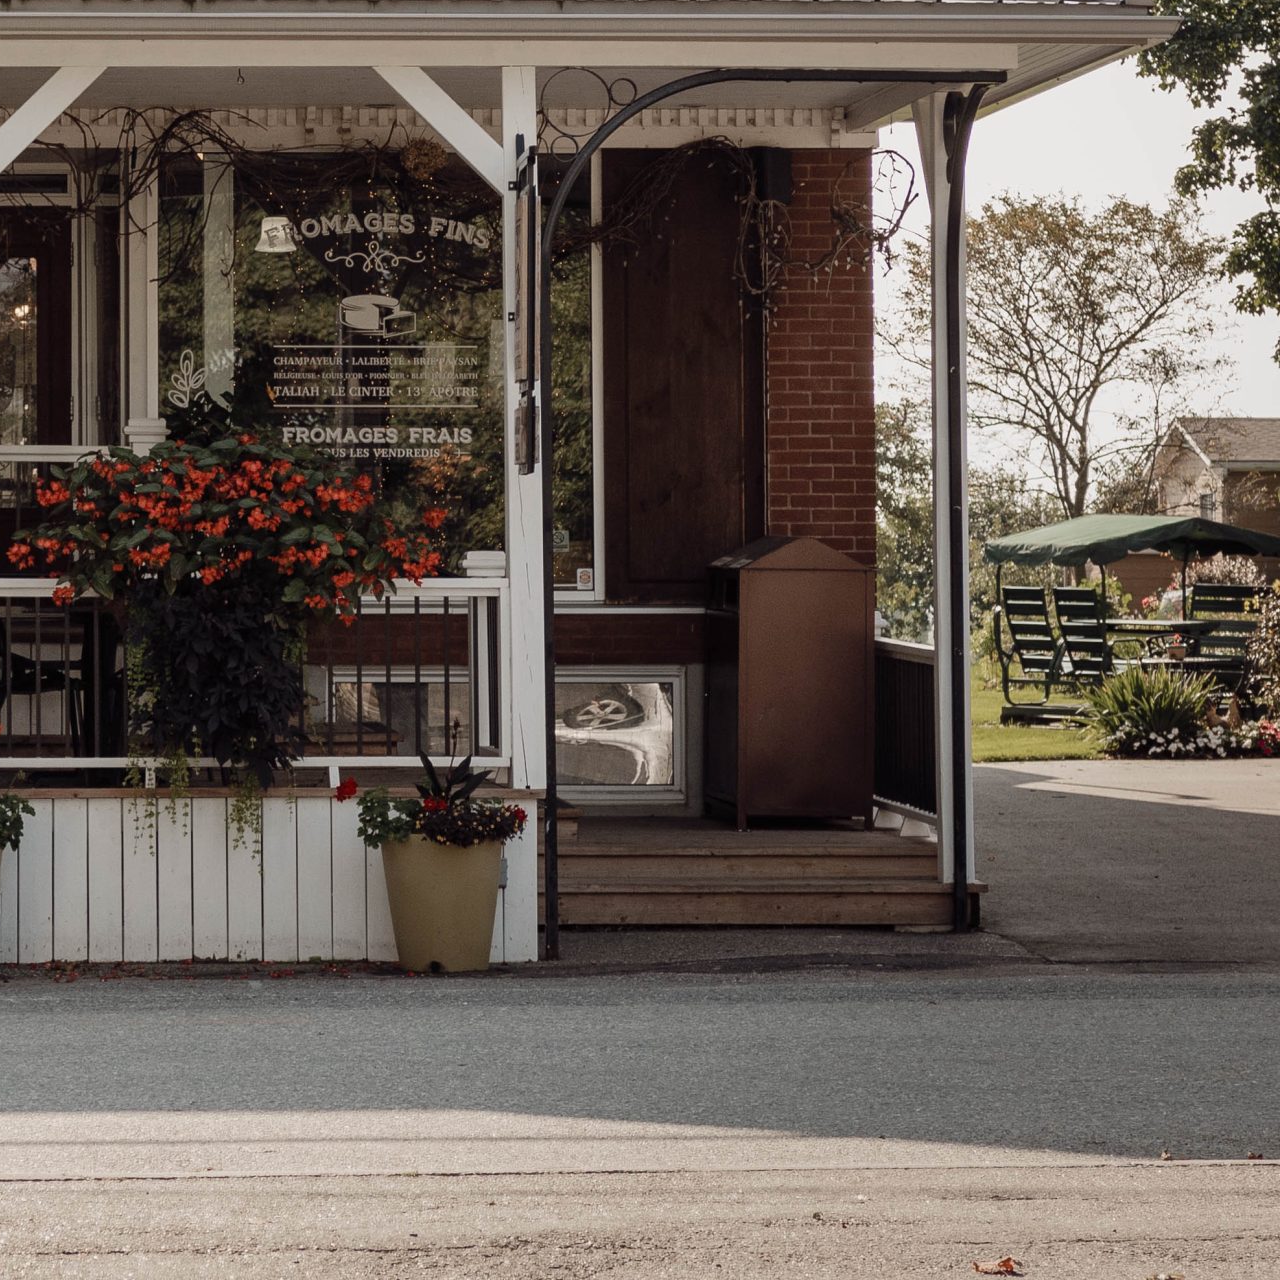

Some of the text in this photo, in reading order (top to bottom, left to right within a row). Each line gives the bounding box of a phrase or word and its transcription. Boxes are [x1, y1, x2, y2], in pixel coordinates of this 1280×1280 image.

[263, 211, 492, 250] FROMAGES FINS
[273, 356, 343, 366] CHAMPAYEUR
[274, 386, 320, 397] TALIAH
[331, 386, 346, 397] LE
[349, 386, 394, 397] CINTER
[429, 384, 479, 397] APÔTRE
[282, 427, 473, 444] FROMAGES FRAIS
[349, 447, 370, 458] LES
[374, 447, 440, 458] VENDREDIS
